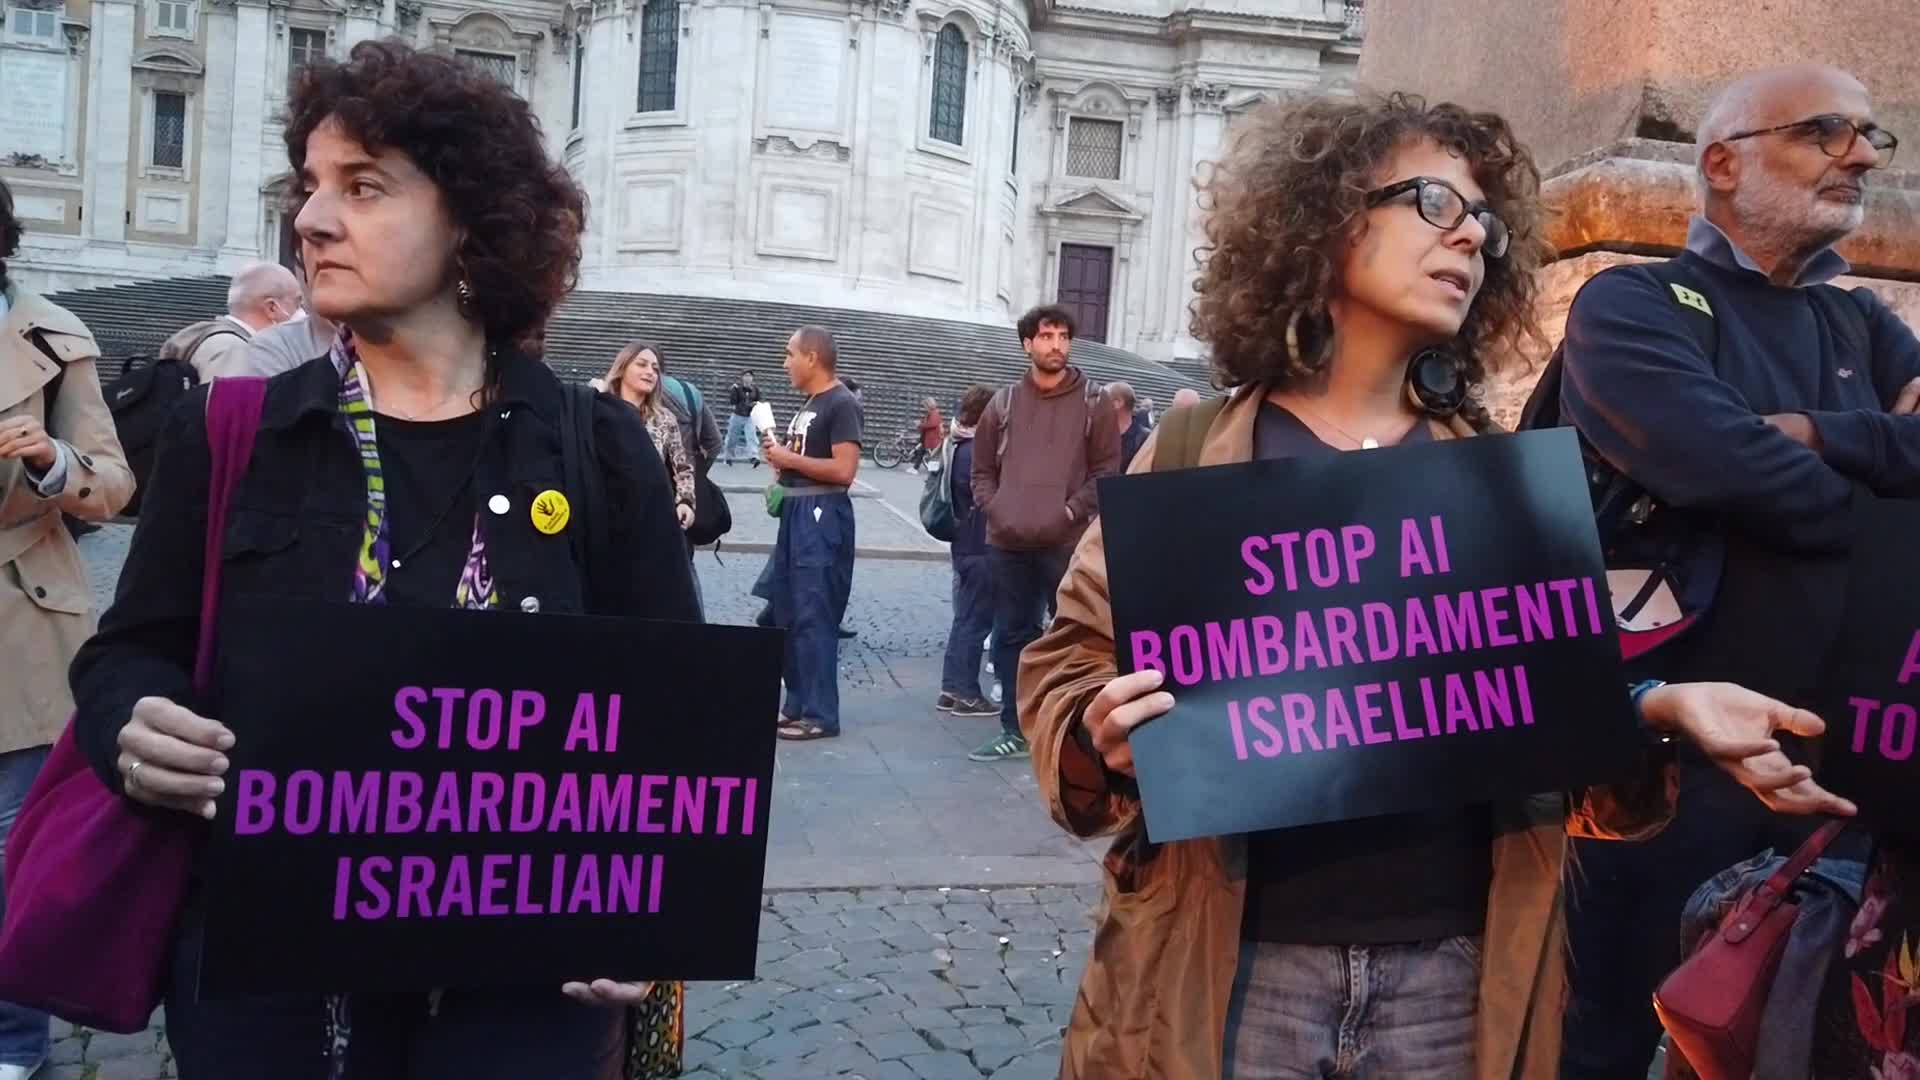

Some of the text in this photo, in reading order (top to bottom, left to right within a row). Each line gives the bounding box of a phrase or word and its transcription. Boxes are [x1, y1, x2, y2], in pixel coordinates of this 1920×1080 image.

[1240, 516, 1452, 597] STOP AI
[1129, 576, 1605, 687] BOMBARDAMENTI
[390, 686, 622, 753] STOP AI
[1226, 664, 1536, 760] ISRAELIANI
[235, 769, 759, 837] BOMBARDAMENTI
[333, 853, 665, 921] ISRAELIANI
